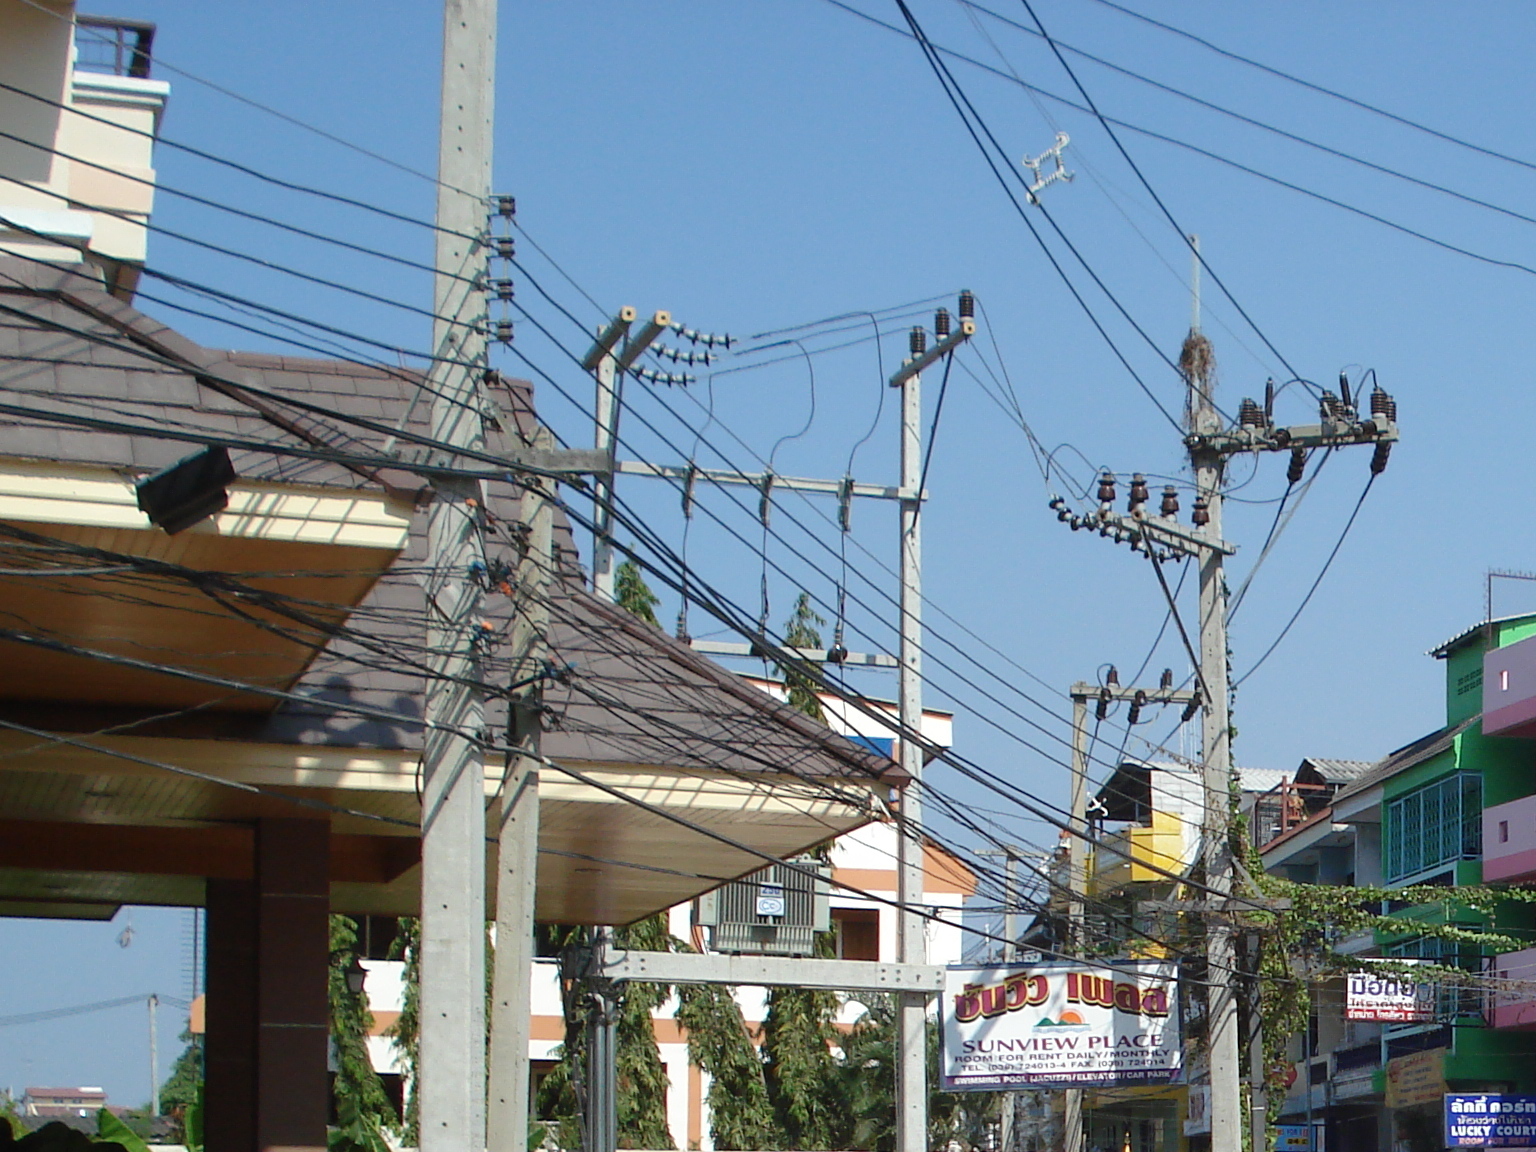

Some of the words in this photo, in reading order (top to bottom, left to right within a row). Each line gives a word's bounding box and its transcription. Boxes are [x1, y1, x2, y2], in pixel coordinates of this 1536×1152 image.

[962, 1036, 1079, 1054] SUNVIEW
[1087, 1034, 1164, 1049] PLACE
[954, 1055, 993, 1063] ROOM
[998, 1054, 1024, 1062] FOR
[1029, 1053, 1063, 1061] RENT
[1004, 1075, 1028, 1084] POOL
[1450, 1125, 1492, 1137] LUCKY
[1495, 1125, 1536, 1137] COURT
